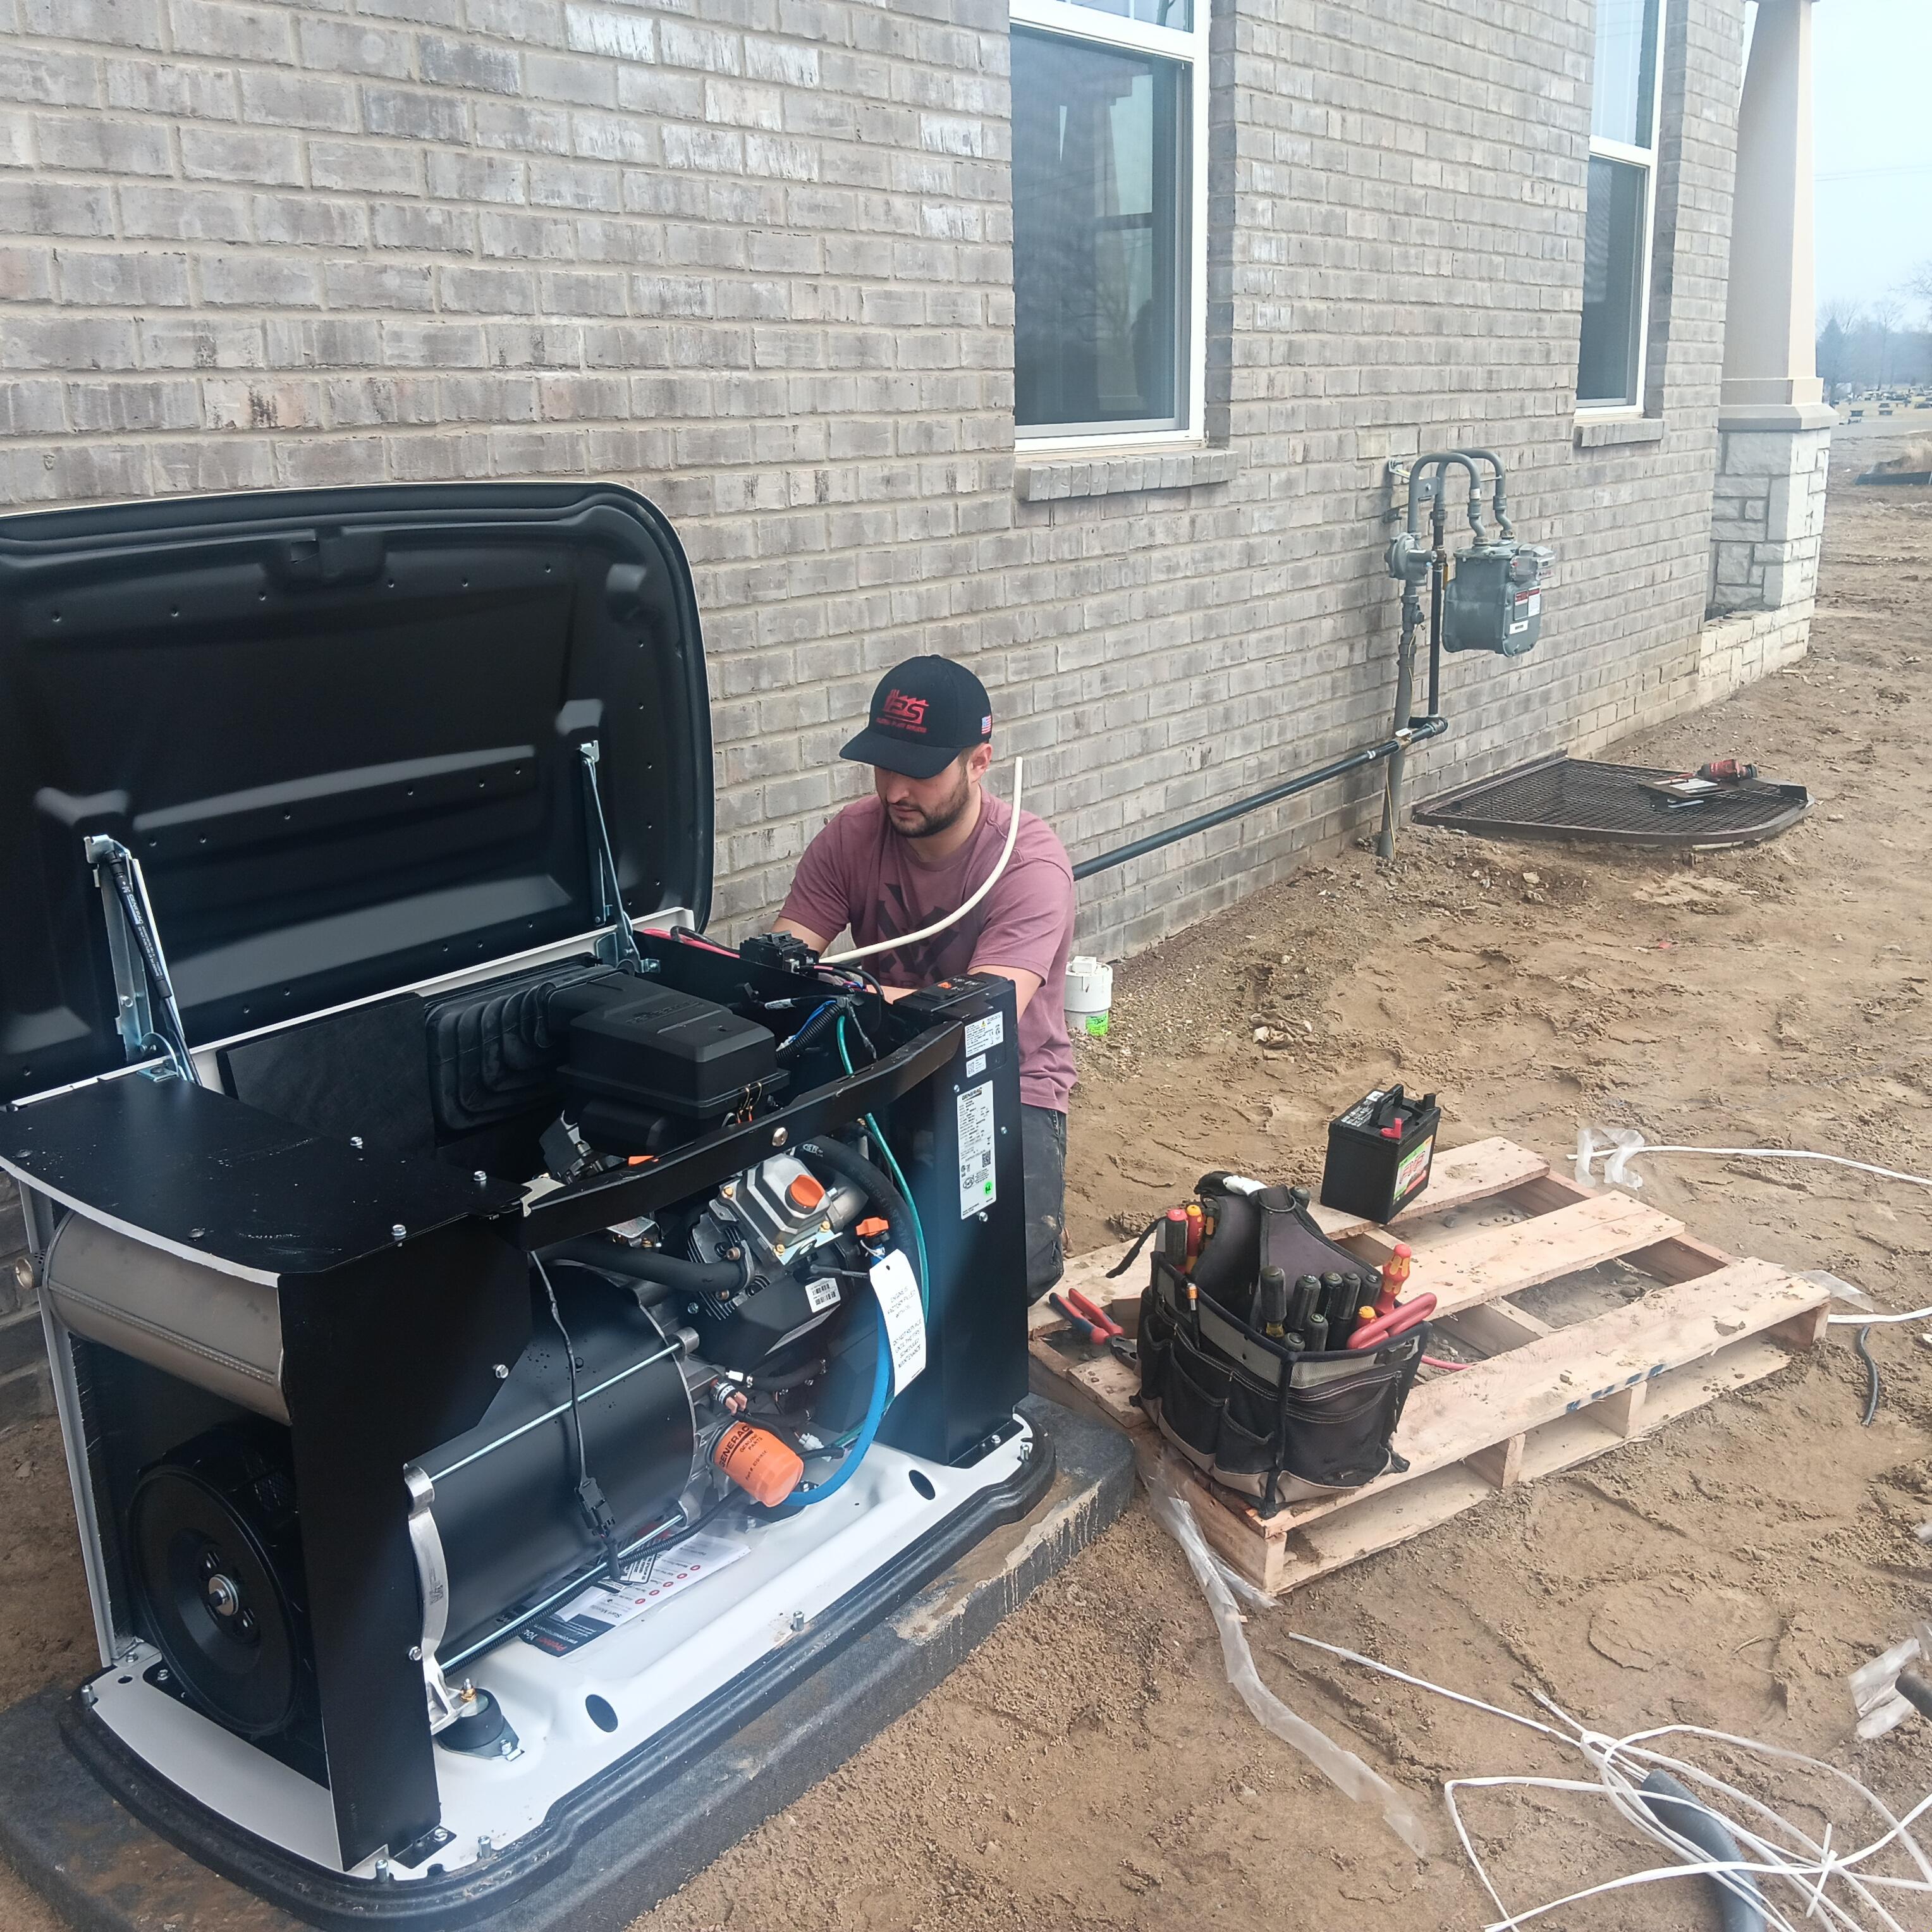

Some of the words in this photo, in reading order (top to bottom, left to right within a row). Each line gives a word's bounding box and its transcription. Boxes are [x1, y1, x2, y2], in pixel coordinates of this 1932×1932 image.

[128, 893, 144, 924] GENERAC
[719, 1425, 750, 1468] GENERAC
[739, 1433, 758, 1453] GENUINE
[748, 1436, 763, 1450] PARTS
